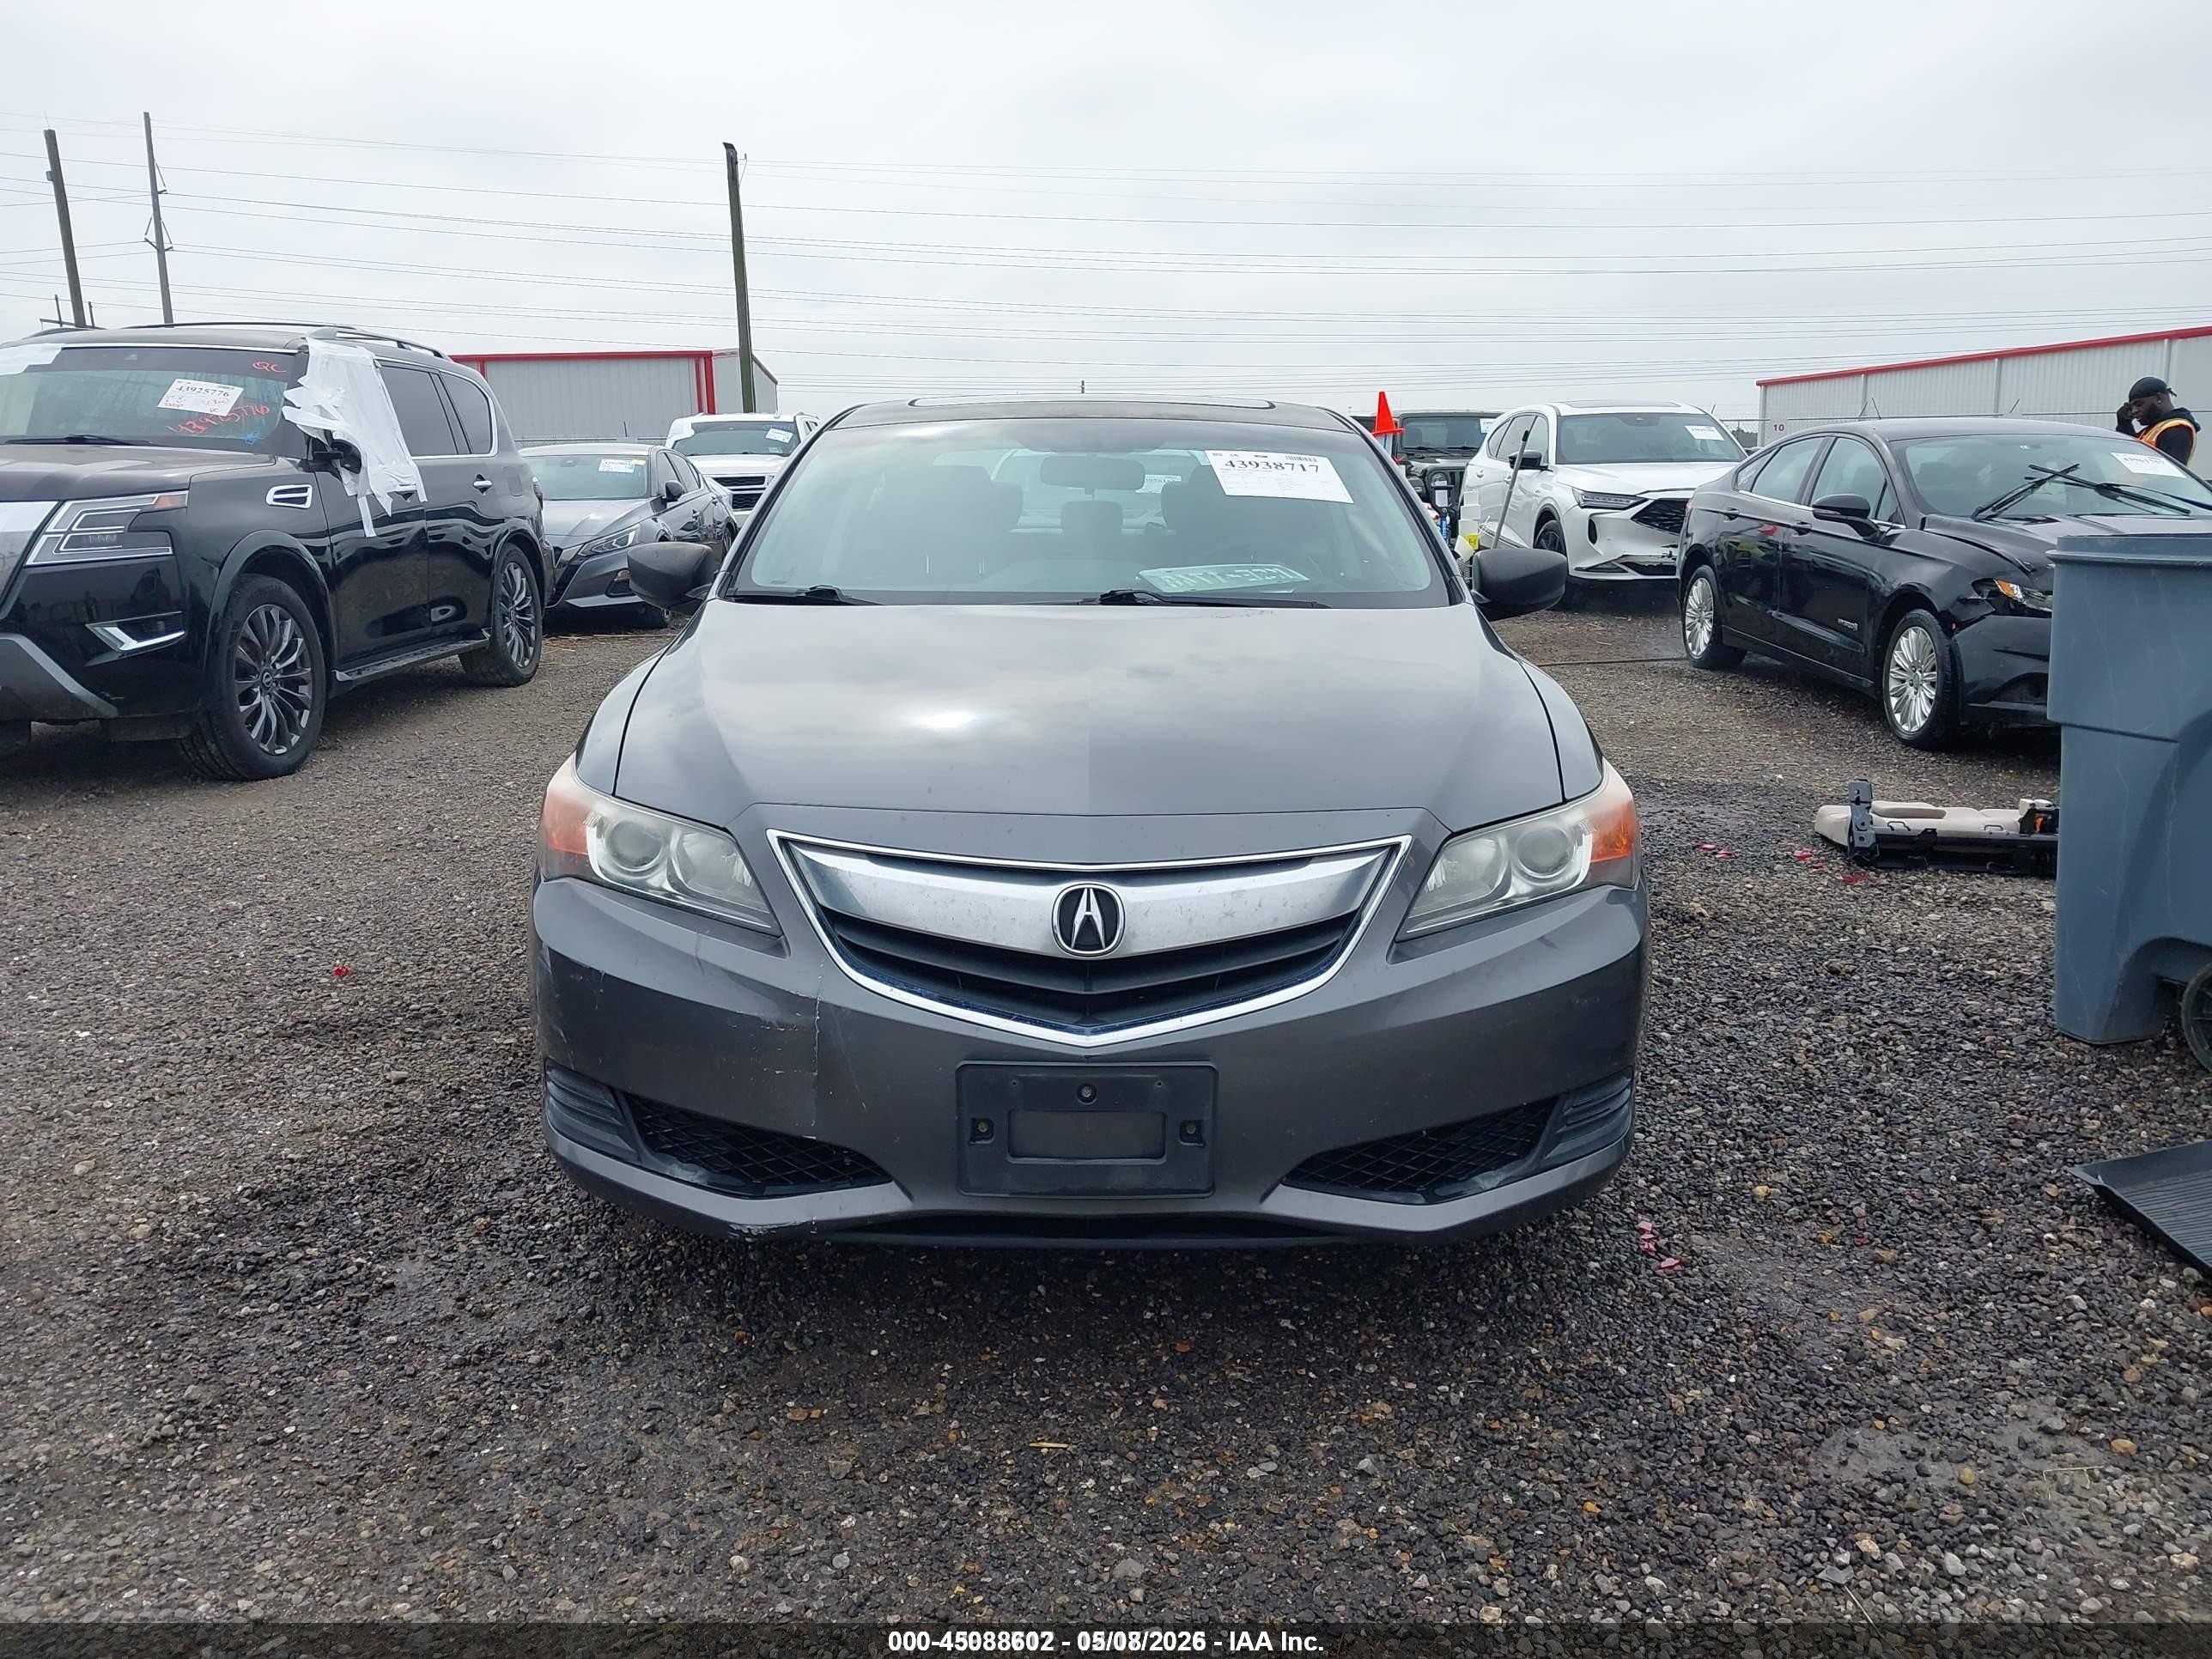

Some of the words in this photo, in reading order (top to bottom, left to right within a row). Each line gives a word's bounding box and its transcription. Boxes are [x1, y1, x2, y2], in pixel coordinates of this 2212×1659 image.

[175, 386, 230, 398] 43925776
[1773, 423, 1784, 432] 10
[1224, 460, 1319, 473] 43938717
